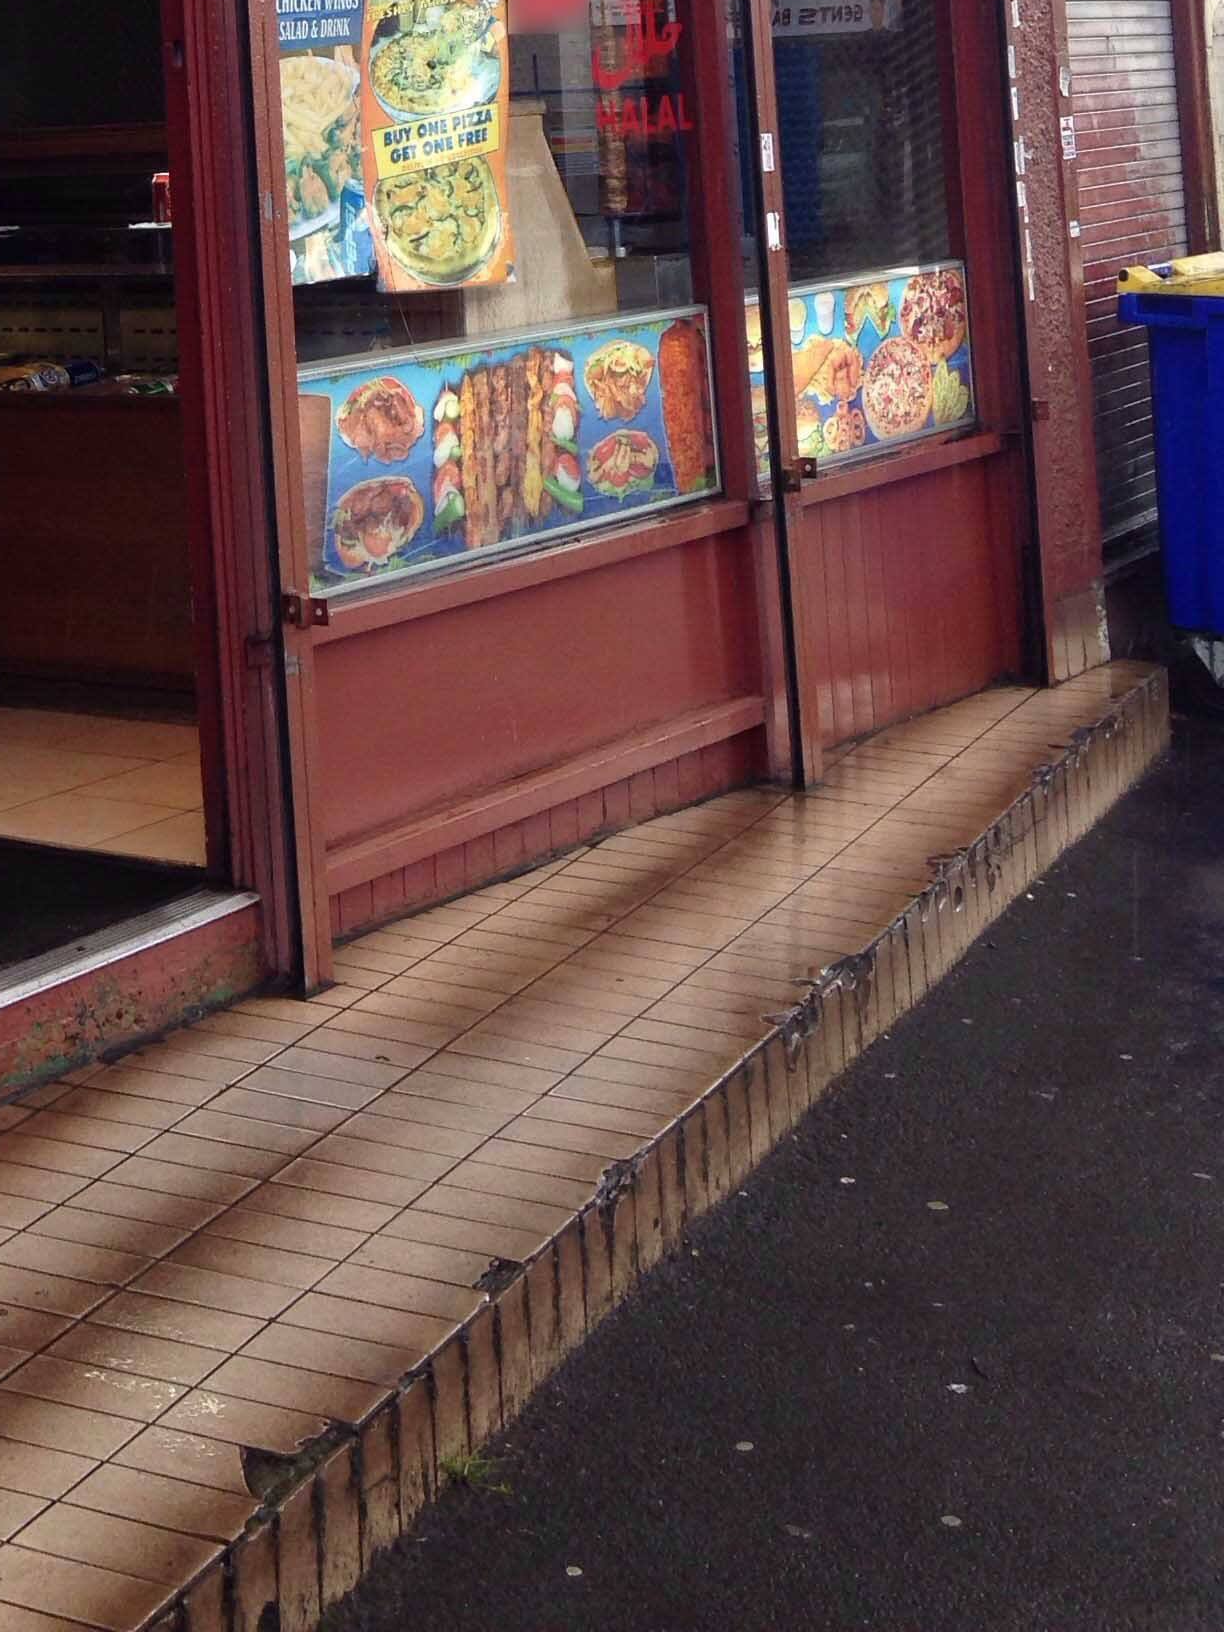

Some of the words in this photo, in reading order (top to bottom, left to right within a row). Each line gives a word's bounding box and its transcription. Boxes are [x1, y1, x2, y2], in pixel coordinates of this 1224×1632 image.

[279, 20, 309, 41] SALAD
[310, 19, 319, 39] &
[320, 17, 351, 38] DRINK
[384, 127, 412, 147] BUY
[417, 119, 448, 139] ONE
[452, 109, 493, 130] PIZZA
[596, 92, 694, 133] HALAL
[390, 144, 417, 164] GET
[422, 136, 454, 156] ONE
[458, 128, 488, 148] FREE
